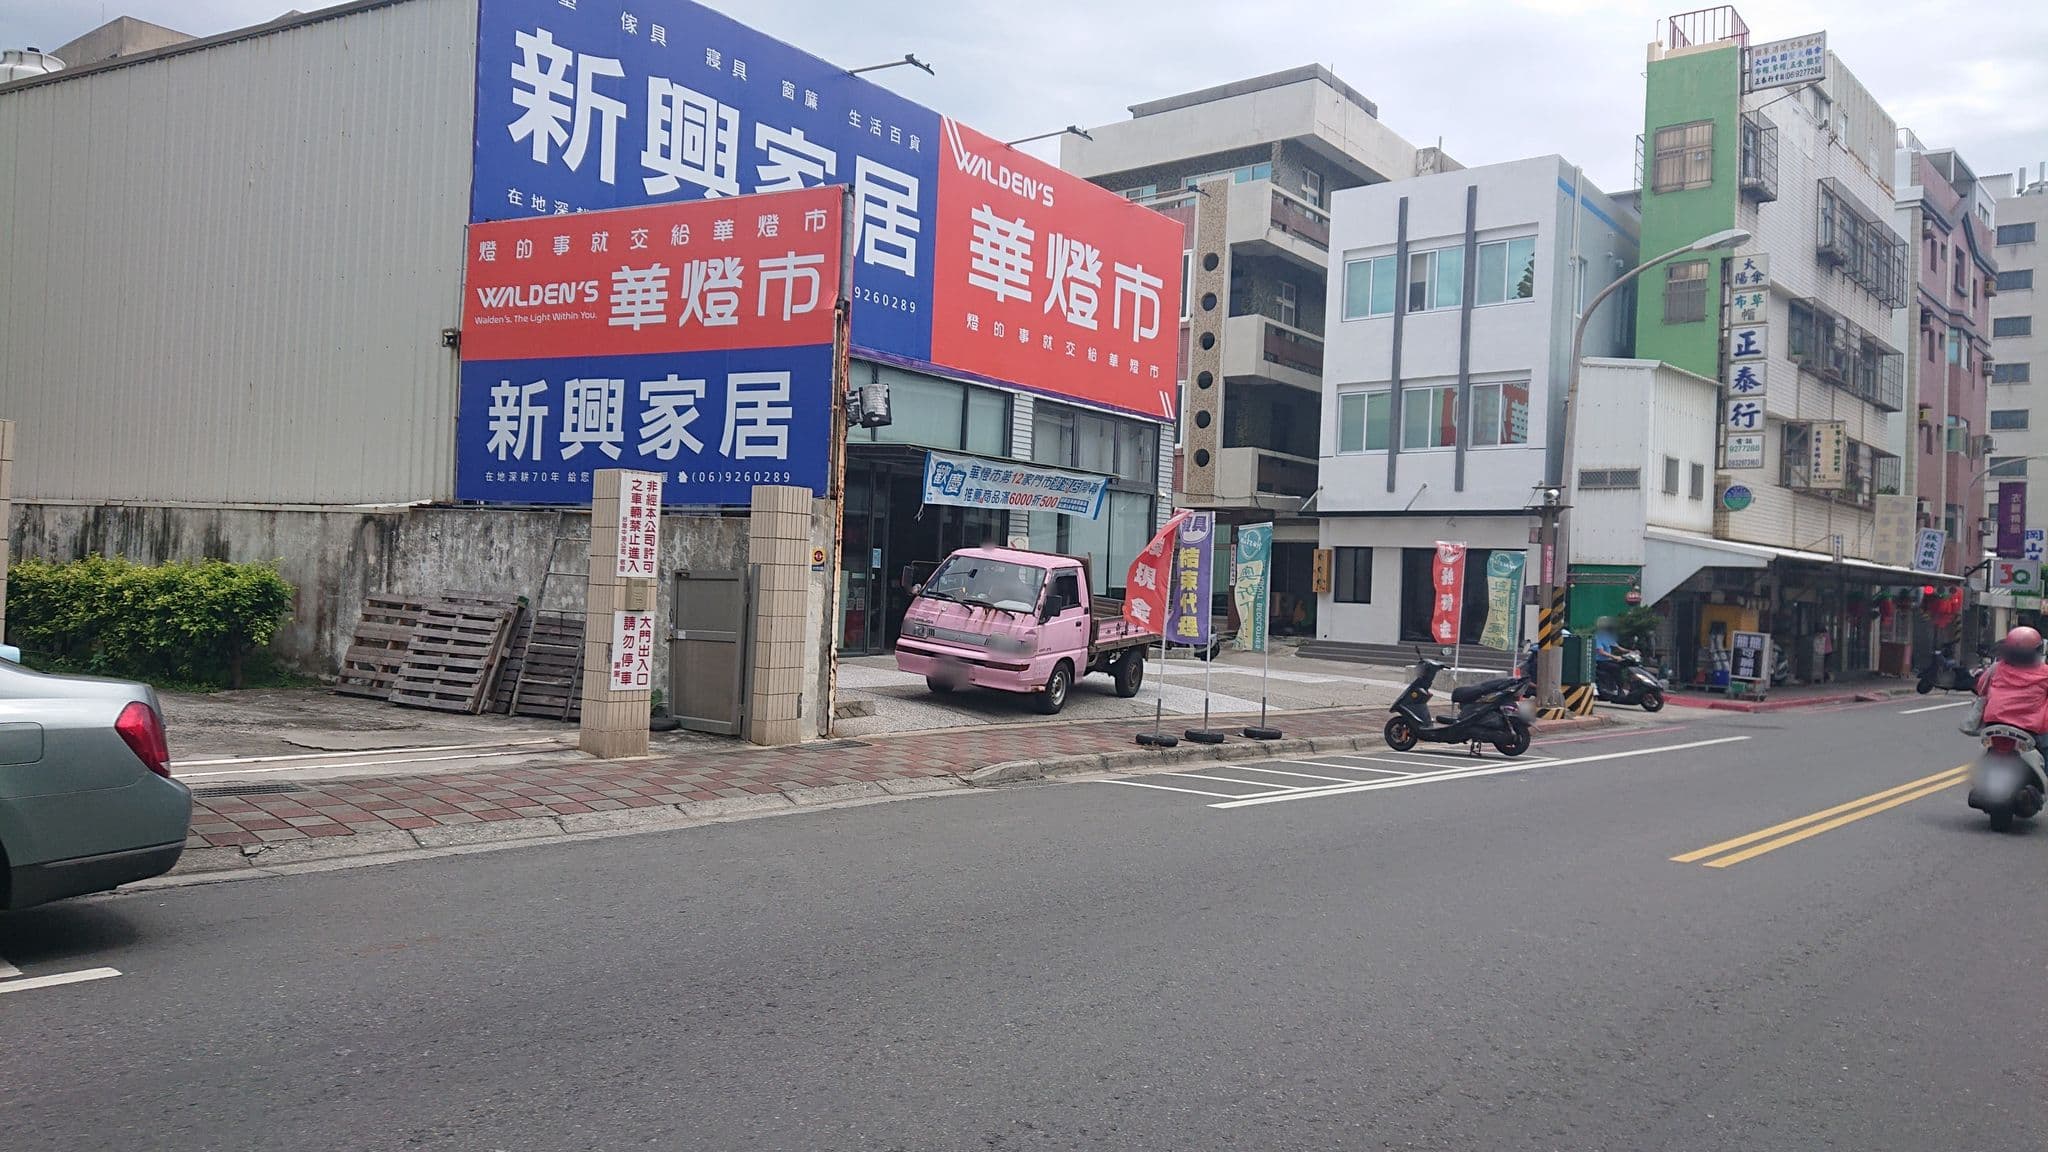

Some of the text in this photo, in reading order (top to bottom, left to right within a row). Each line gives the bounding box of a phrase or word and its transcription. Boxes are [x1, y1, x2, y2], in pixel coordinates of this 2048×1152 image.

[621, 11, 921, 153] 傢具 寢具 窗簾 生活百貨
[957, 151, 1056, 208] WALDEN'S
[478, 208, 827, 263] 燈的事就交給華燈市
[476, 280, 599, 309] WALDEN'S
[608, 251, 825, 331] 華燈市
[968, 203, 1163, 343] 華燈市
[514, 314, 528, 324] The
[530, 313, 551, 325] Light
[553, 312, 578, 322] Within
[966, 312, 1159, 379] 燈的事就交給華燈市
[1730, 331, 1762, 428] 正泰行
[487, 371, 793, 462] 新興家居
[485, 470, 561, 483] 在地深耕70年
[627, 479, 643, 573] 之車輛禁止進入
[643, 480, 658, 573] 非經本公司許可
[1177, 547, 1200, 637] 結束代理
[2000, 564, 2031, 585] 3Q
[620, 616, 636, 685] 請勿停車
[637, 616, 652, 685] 大門出入口
